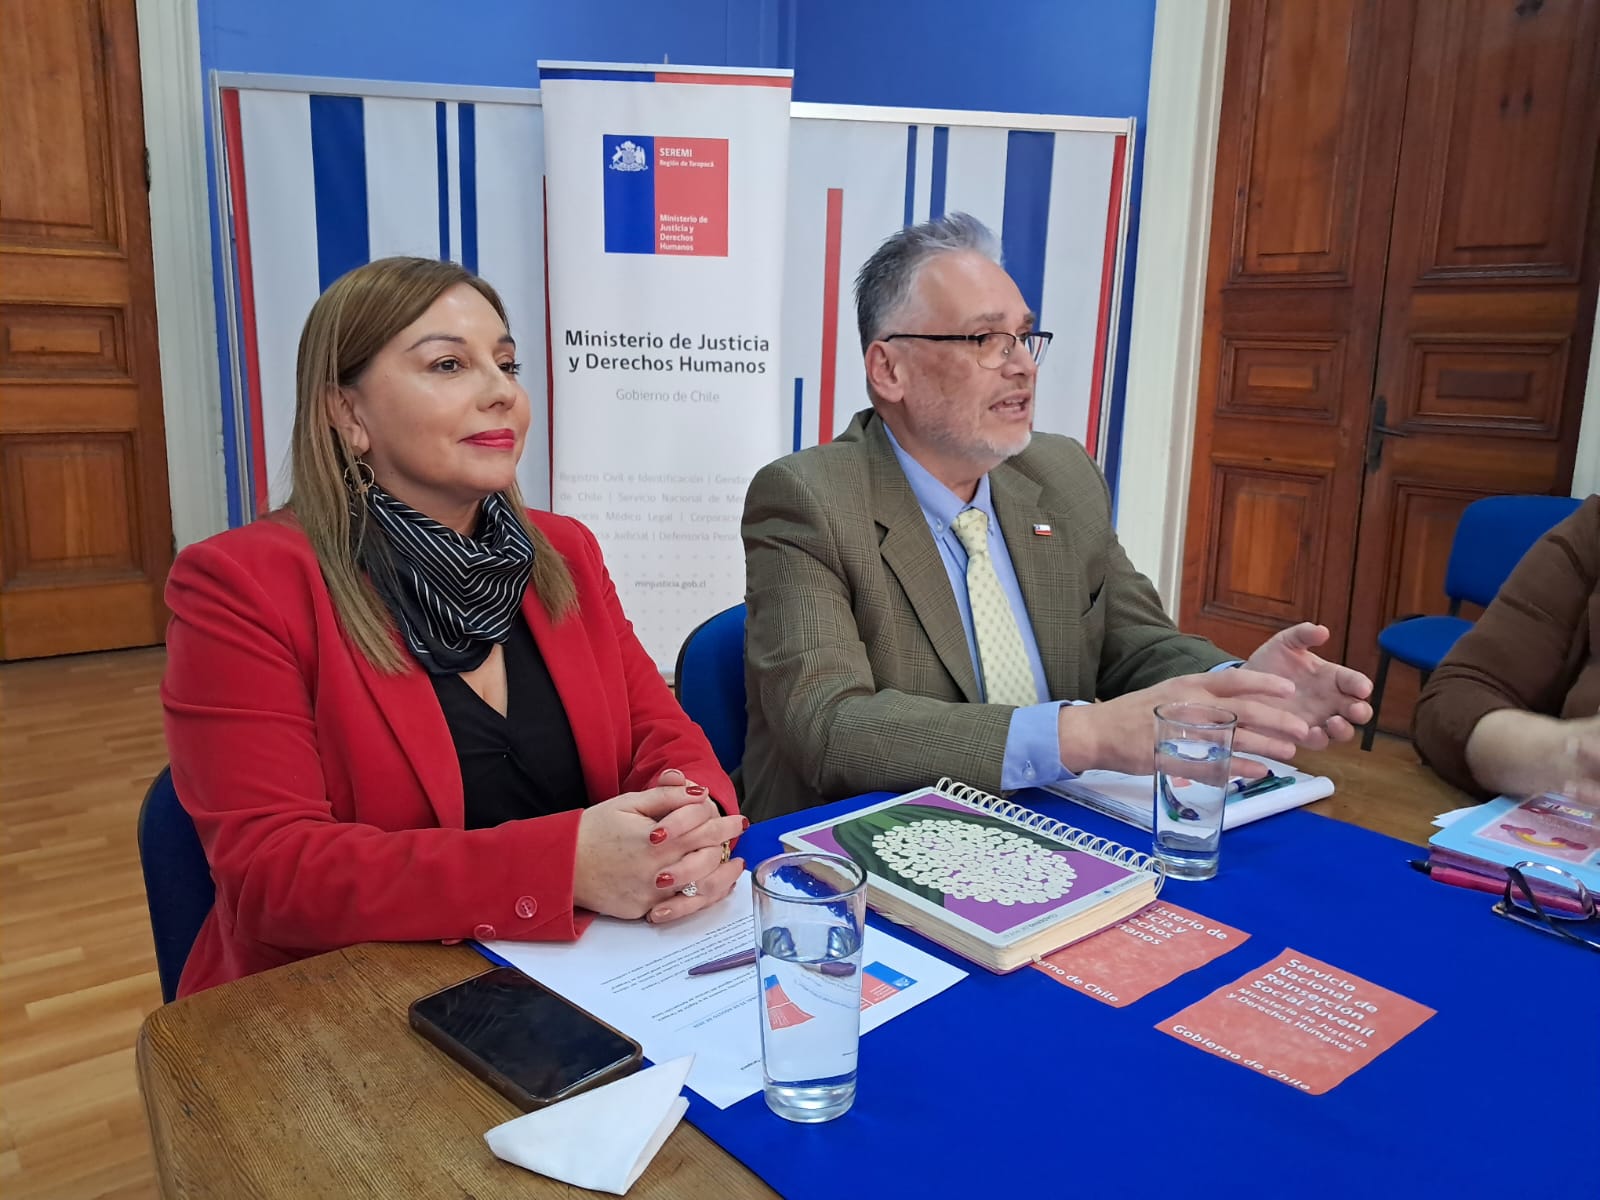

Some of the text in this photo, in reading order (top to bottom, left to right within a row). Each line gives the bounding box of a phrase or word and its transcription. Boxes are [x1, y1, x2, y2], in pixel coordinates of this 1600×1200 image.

[659, 148, 692, 157] SEREMI
[659, 159, 680, 168] Región
[659, 214, 708, 223] Ministerio de
[659, 224, 694, 234] Justicia y
[659, 233, 694, 242] Derechos
[659, 242, 694, 251] Humanos
[565, 330, 770, 351] Ministerio de Justicia
[568, 353, 766, 374] y Derechos Humanos
[616, 388, 721, 403] Gobierno de Chile
[634, 580, 706, 589] minjusticia.gob.cl
[1128, 918, 1174, 939] echos
[1151, 905, 1228, 940] isterio de
[1171, 926, 1188, 934] y
[1286, 959, 1356, 993] Servicio
[1065, 974, 1083, 985] de
[1084, 982, 1120, 1003] Chile
[1263, 973, 1365, 1021] Reinserción
[1274, 966, 1378, 1014] Nacional de
[1237, 987, 1368, 1049] Ministerio de Justicia
[1250, 980, 1376, 1038] Social Juvenil
[1226, 992, 1354, 1053] y Derechos Humanos
[1172, 1024, 1311, 1091] Gobierno de Chile
